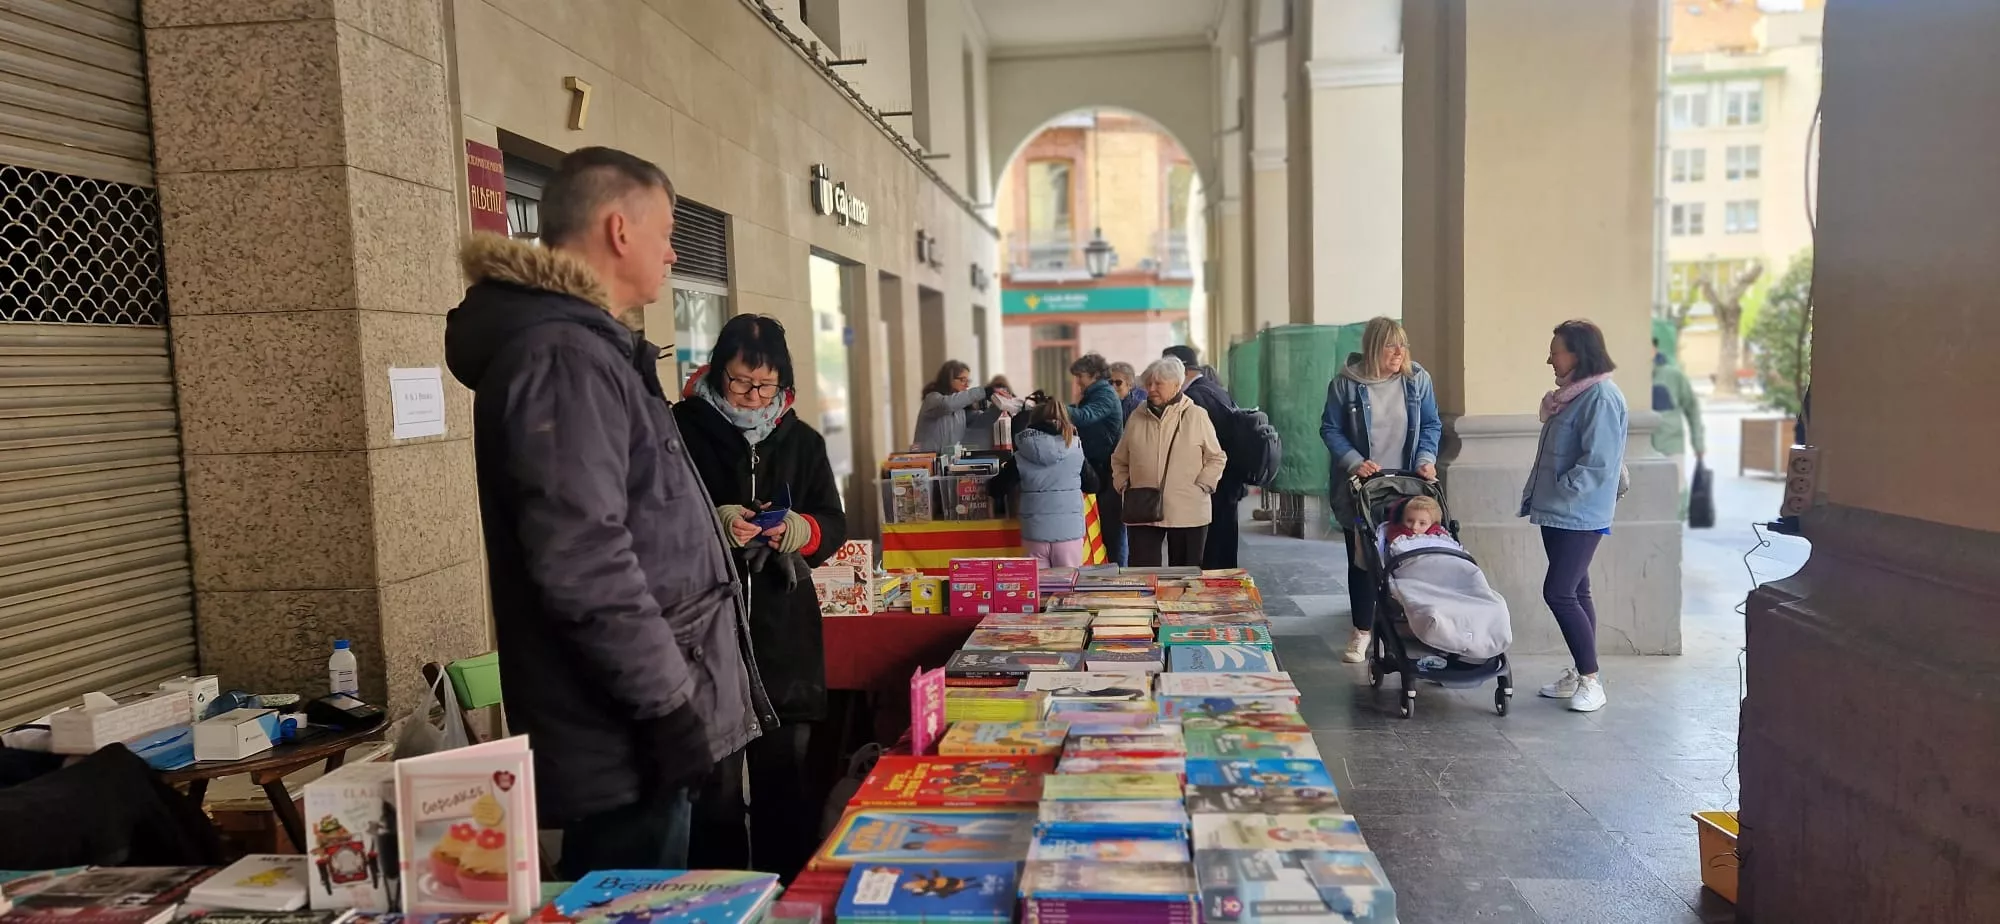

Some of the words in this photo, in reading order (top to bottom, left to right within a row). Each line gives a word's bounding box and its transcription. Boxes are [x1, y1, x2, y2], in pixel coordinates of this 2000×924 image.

[564, 76, 592, 130] 7
[834, 181, 869, 227] cajamar
[837, 543, 867, 560] BOX
[422, 786, 485, 815] Cupcakes
[594, 876, 743, 894] Beginning
